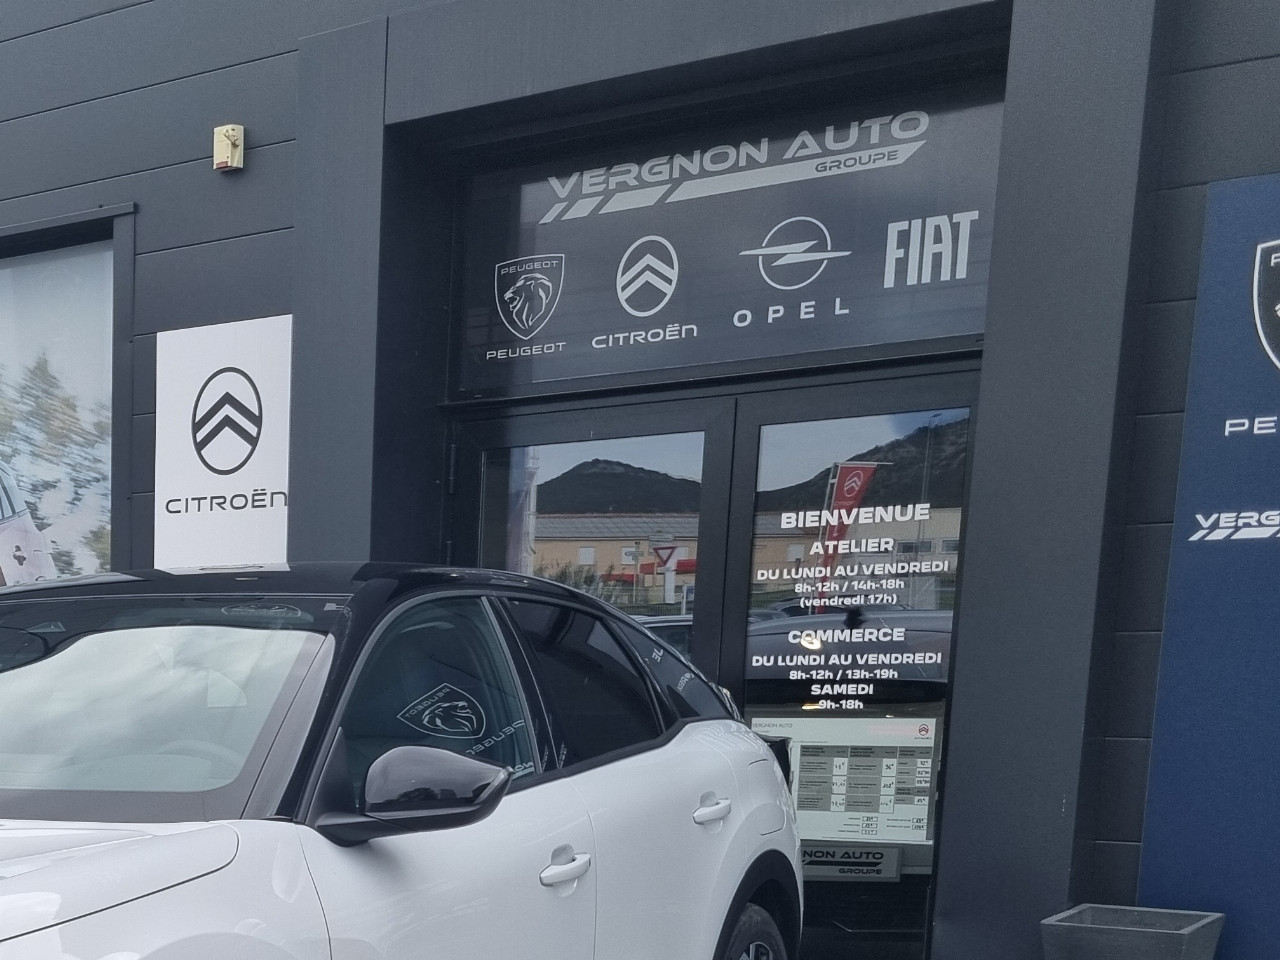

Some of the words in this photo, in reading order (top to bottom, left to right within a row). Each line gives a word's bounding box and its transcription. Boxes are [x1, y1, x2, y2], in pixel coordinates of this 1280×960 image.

[547, 137, 770, 199] VERGNON
[783, 110, 930, 159] AUTO
[814, 149, 900, 173] GROUPE
[883, 210, 980, 289] FIAT
[500, 260, 560, 276] PEUGEOT
[732, 297, 850, 328] OPEL
[486, 342, 567, 360] PEUGEOT
[780, 503, 931, 529] BIENVENUE
[809, 537, 895, 556] ATELIER
[757, 568, 780, 580] DU
[783, 566, 831, 579] LUNDI
[833, 564, 858, 577] AU
[862, 560, 949, 575] VENDREDI
[794, 582, 840, 594] 8h-12h
[851, 579, 905, 591] 14h-18h
[800, 595, 865, 608] (vendredi
[867, 593, 898, 606] 17h)
[787, 627, 906, 644] COMMERCE
[751, 655, 775, 667] DU
[777, 654, 825, 667] LUNDI
[828, 653, 852, 665] AU
[856, 652, 942, 666] VENDREDI
[789, 669, 834, 680] 8h-12h
[845, 668, 899, 680] 13h-19h
[810, 683, 874, 696] SAMEDI
[819, 698, 864, 710] 9h-18h
[839, 851, 884, 860] AUTO
[838, 867, 883, 875] GROUPE
